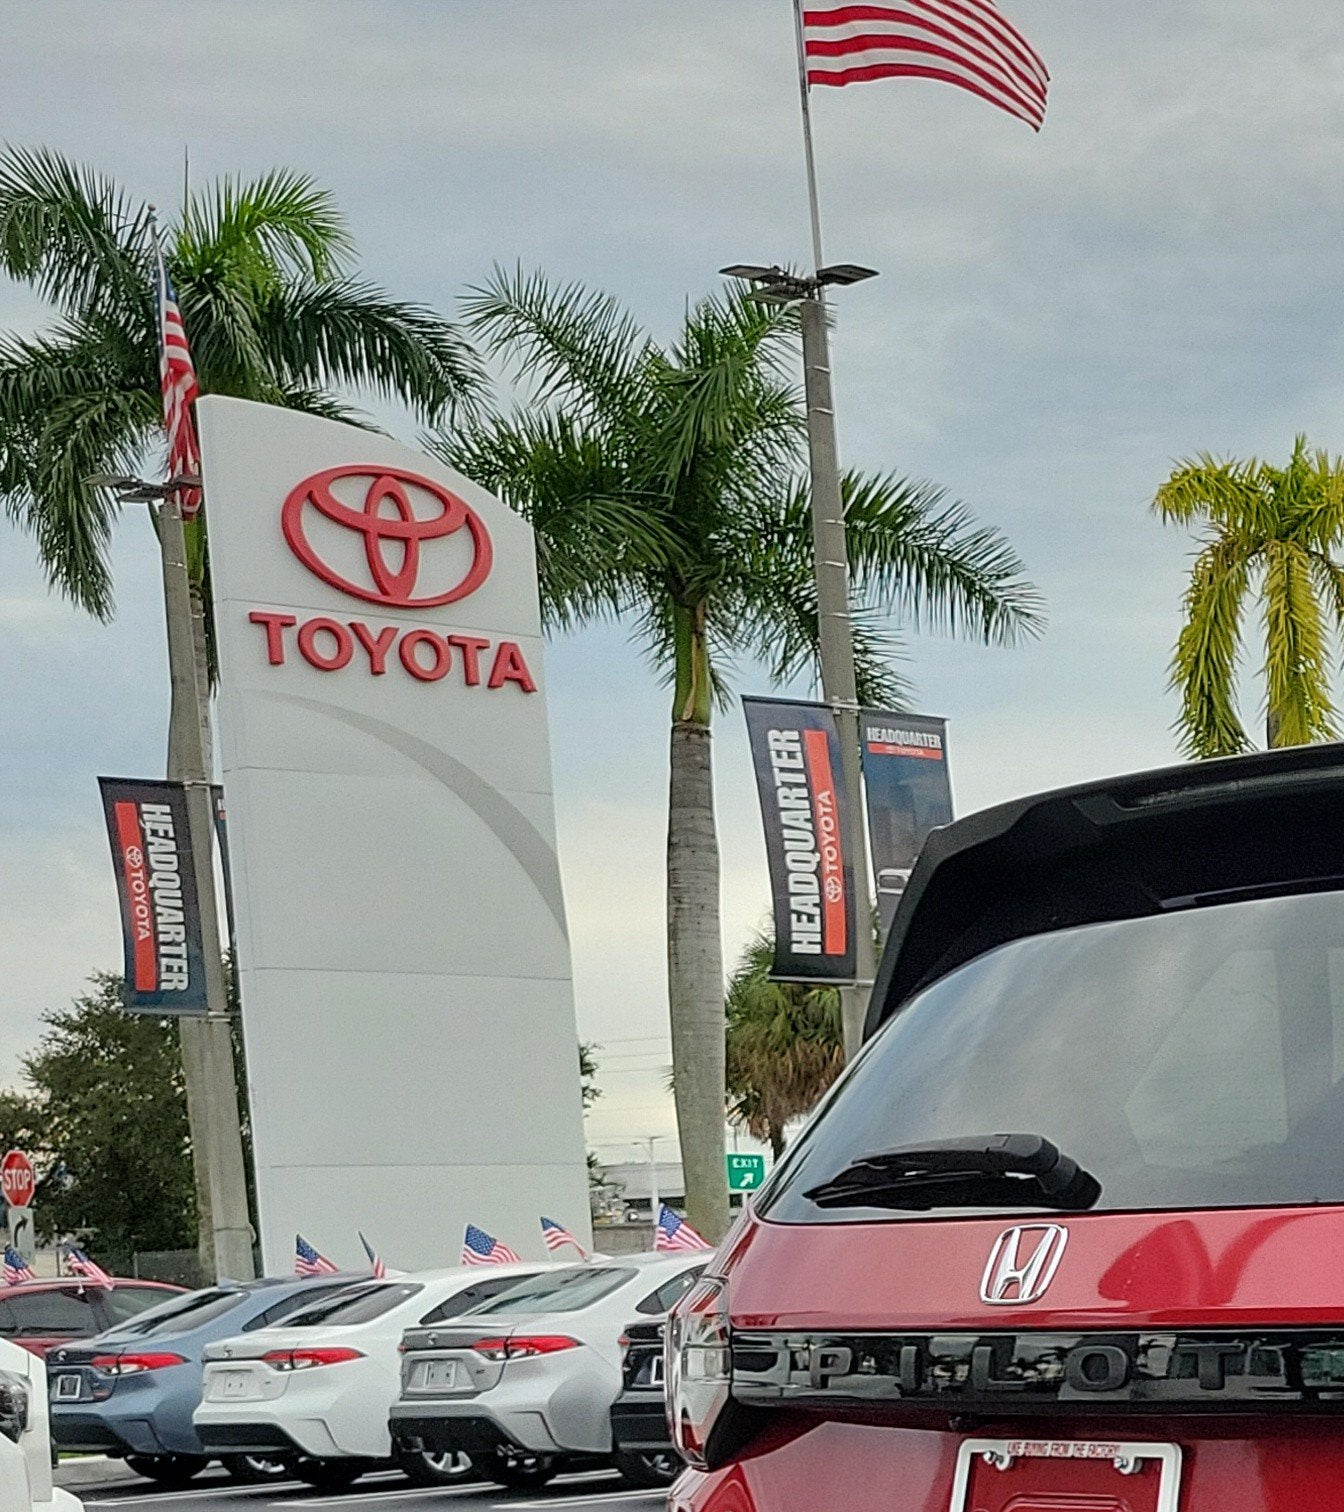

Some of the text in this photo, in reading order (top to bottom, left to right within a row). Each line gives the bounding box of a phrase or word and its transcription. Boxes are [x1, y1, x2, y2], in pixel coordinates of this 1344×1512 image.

[249, 612, 538, 693] TOYOTA
[867, 726, 942, 749] HEADQUARTER
[767, 729, 823, 955] HEADQUARTER
[815, 790, 840, 874] TOYOTA
[130, 869, 151, 941] TOYOTA
[140, 803, 190, 992] HEADQUARTER
[4, 1169, 31, 1191] STOP
[732, 1157, 759, 1169] EXIT
[809, 1343, 1243, 1392] PILOT
[1051, 1442, 1070, 1457] FROM
[1072, 1443, 1086, 1457] THE
